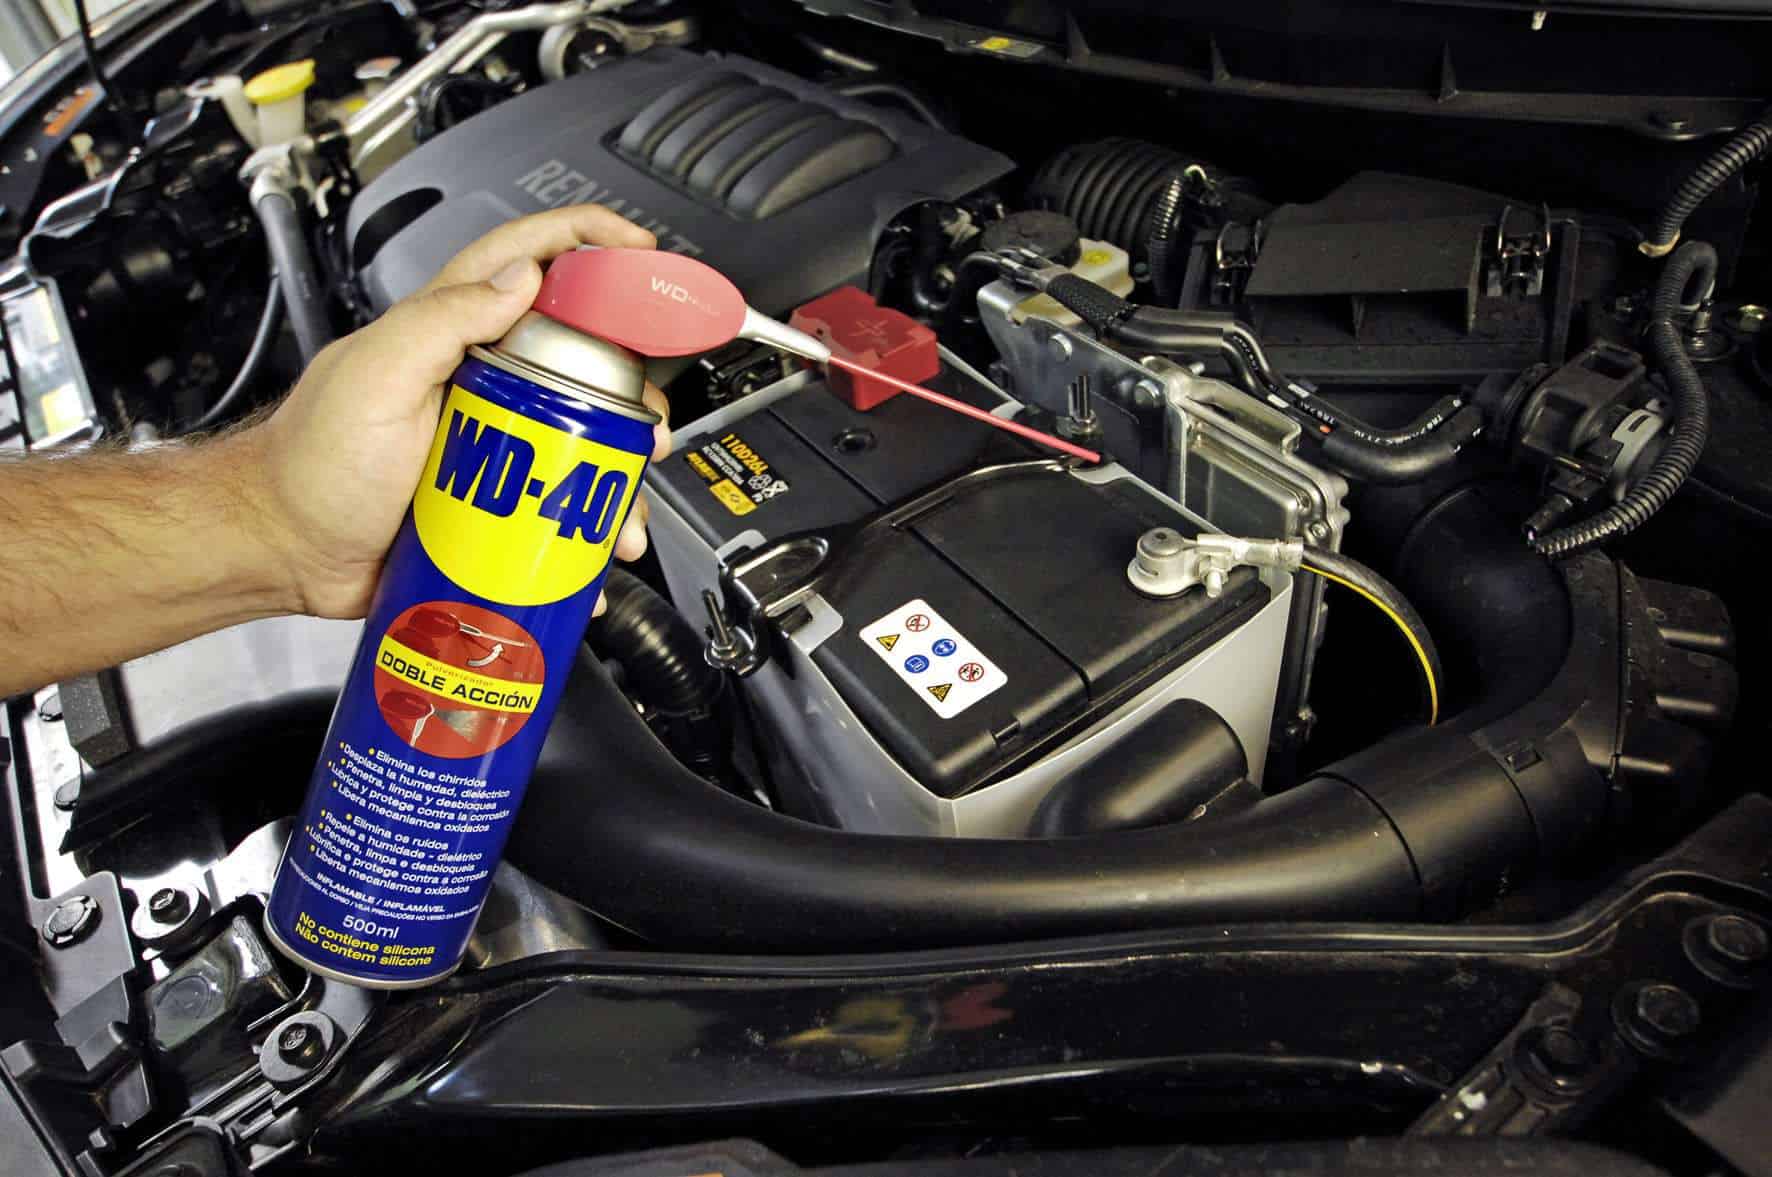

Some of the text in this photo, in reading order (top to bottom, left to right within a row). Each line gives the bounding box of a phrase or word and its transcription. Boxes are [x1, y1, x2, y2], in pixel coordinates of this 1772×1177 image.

[434, 408, 629, 544] WD-40
[381, 650, 533, 709] DOBLE ACCIÓN
[331, 763, 360, 789] Lubrica
[360, 785, 368, 795] y
[369, 790, 414, 811] protege
[417, 807, 455, 820] contra
[457, 811, 467, 821] la
[344, 743, 384, 775] Desplaza
[386, 768, 397, 780] la
[399, 774, 457, 798] humedad,
[346, 760, 497, 812] Penetra, limpia y desbloquea
[376, 750, 487, 788] Elimina los chirridos
[338, 783, 490, 833] Libera mecanismos oxidados
[353, 815, 392, 839] Elimina
[394, 834, 410, 843] os
[309, 826, 342, 856] Lubrifica
[344, 853, 351, 861] e
[353, 858, 399, 878] protege
[401, 872, 439, 884] contra
[324, 825, 362, 855] Penetra,
[366, 848, 397, 865] limpa
[400, 860, 408, 868] e
[325, 811, 356, 837] Repele
[358, 833, 366, 842] a
[367, 835, 425, 859] humidade
[315, 848, 346, 873] Liberta
[348, 869, 422, 894] mecanismos
[424, 886, 470, 895] oxidados
[317, 872, 375, 904] INFLAMABLE
[295, 922, 319, 943] Não
[379, 955, 432, 966] silicone
[299, 911, 435, 955] No contiene silicona
[342, 914, 400, 939] 500ml
